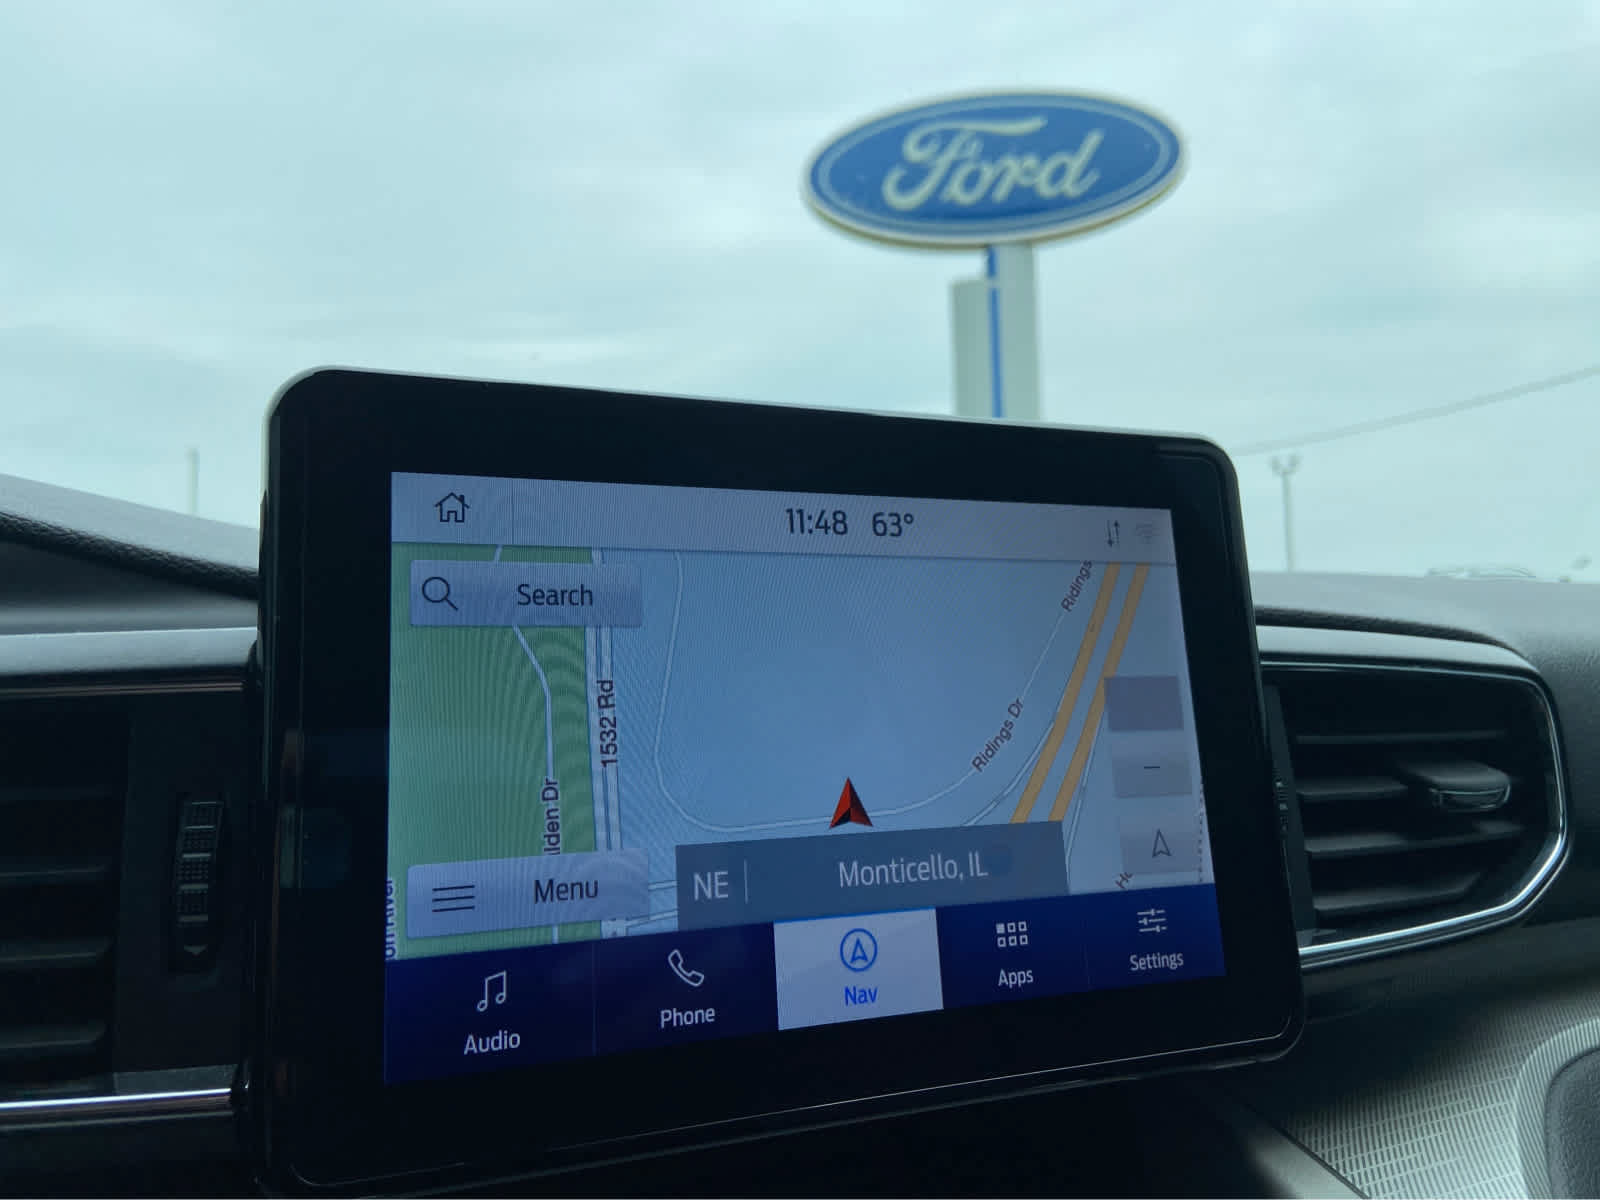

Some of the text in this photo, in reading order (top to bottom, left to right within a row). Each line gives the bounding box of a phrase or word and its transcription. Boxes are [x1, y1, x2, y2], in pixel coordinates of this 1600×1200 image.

[881, 115, 1104, 212] Ford
[785, 508, 914, 538] 11:48 63°
[517, 583, 594, 607] Search
[596, 679, 618, 769] 1532 Rd
[971, 697, 1024, 773] Ridings Dr
[541, 777, 561, 856] lden Dr
[838, 851, 989, 889] Monticello, IL
[533, 877, 599, 904] Menu
[693, 870, 729, 901] NE
[1129, 950, 1185, 972] Settings
[998, 967, 1034, 988] Apps
[844, 985, 878, 1007] Nav
[660, 1006, 716, 1029] Phone
[463, 1030, 521, 1055] Audio
